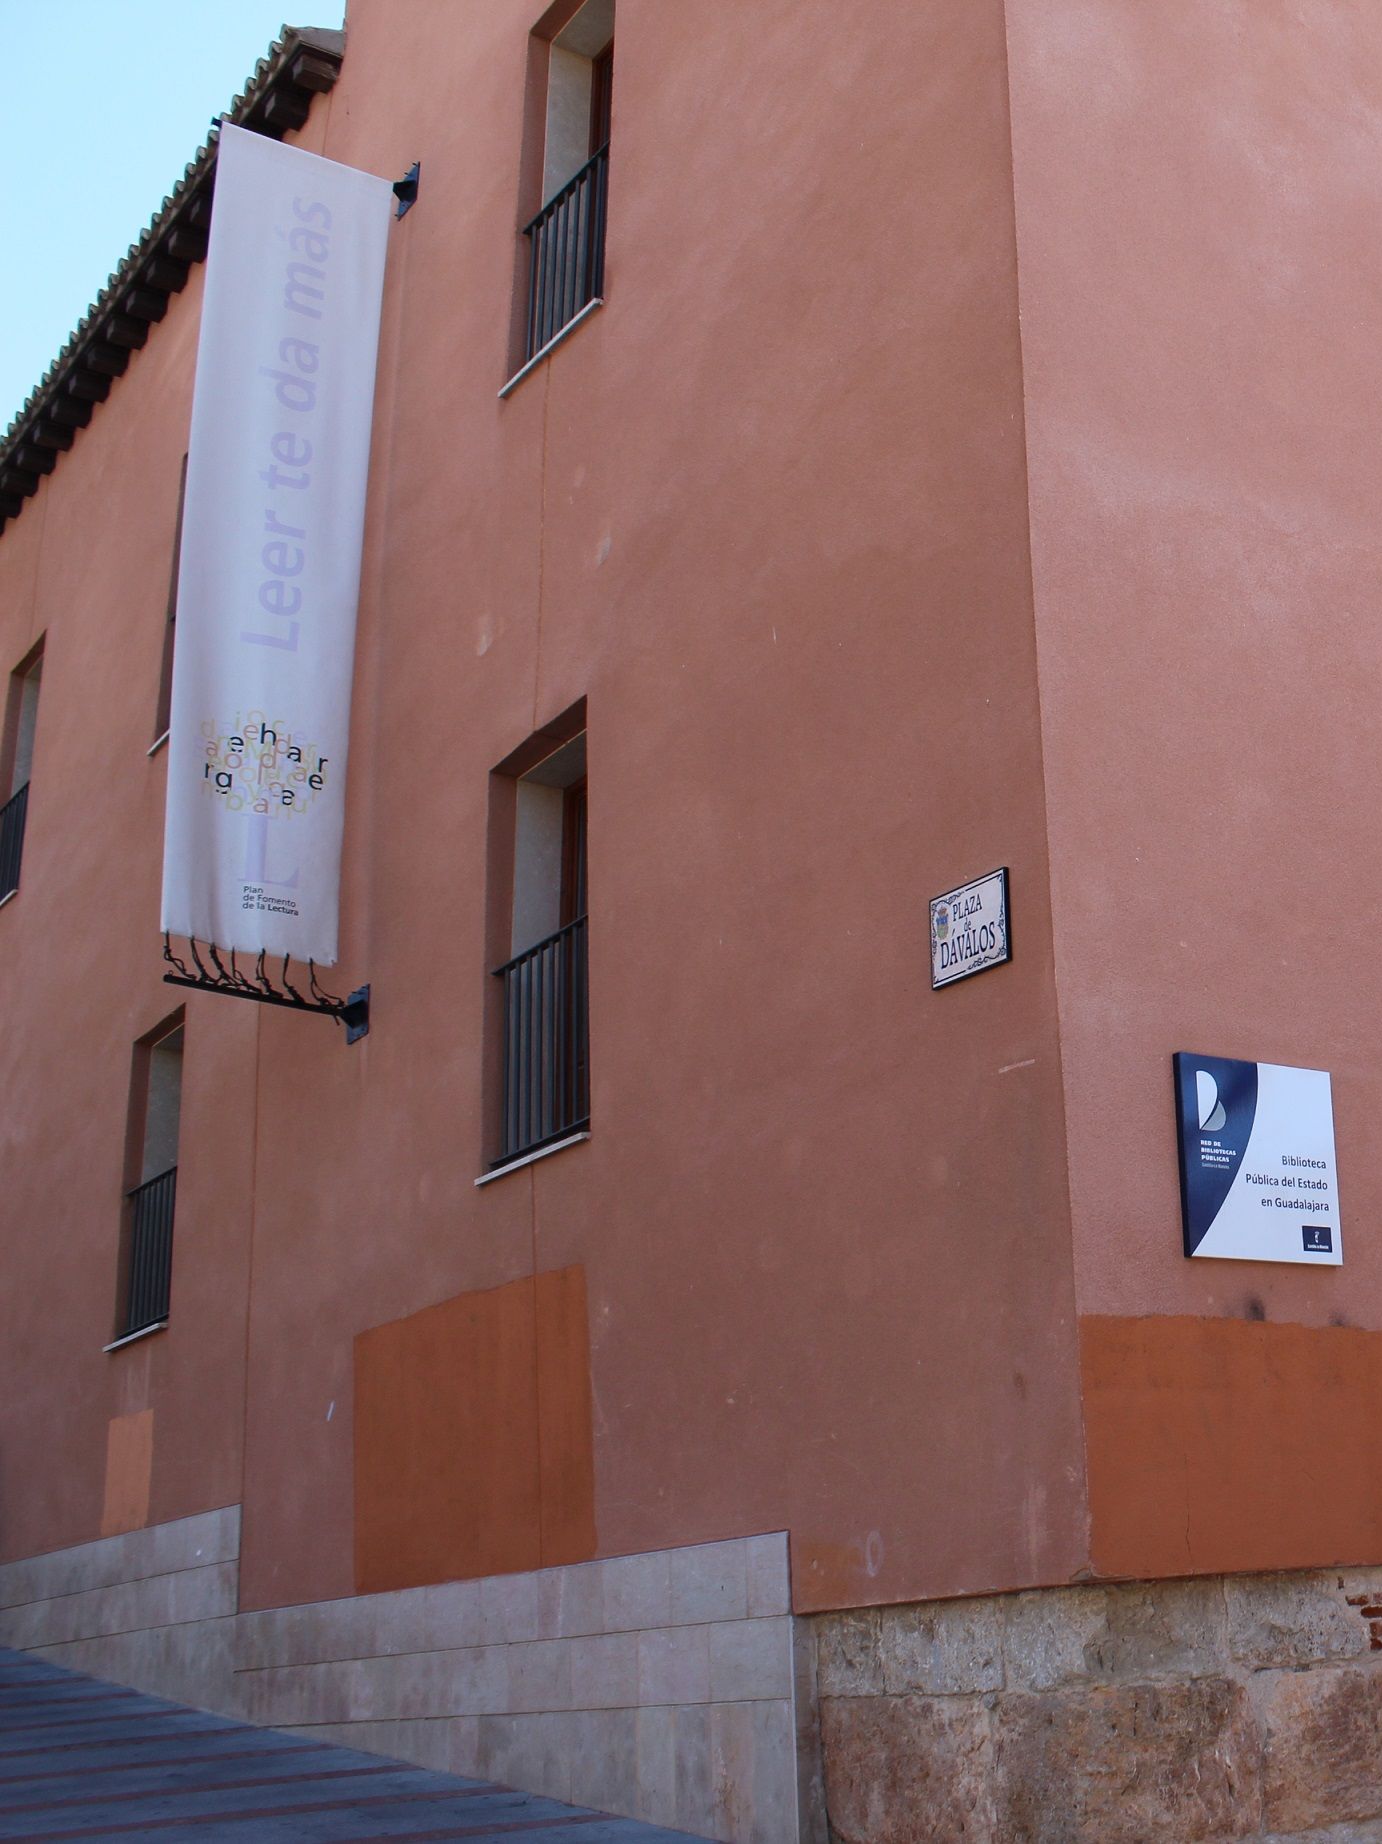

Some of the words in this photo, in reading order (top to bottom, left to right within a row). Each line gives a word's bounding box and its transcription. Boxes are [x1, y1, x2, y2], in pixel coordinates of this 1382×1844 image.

[274, 196, 334, 321] más
[258, 337, 321, 412] da
[258, 430, 314, 492] te
[240, 508, 306, 653] Leer
[243, 885, 264, 894] Plan
[242, 901, 255, 910] de
[256, 901, 266, 910] la
[267, 903, 300, 917] Lectura
[257, 894, 297, 908] Fomento
[952, 893, 982, 921] PLAZA
[963, 917, 973, 932] de
[940, 921, 996, 969] DÁVALOS
[1281, 1155, 1327, 1169] Biblioteca
[1245, 1173, 1280, 1187] Pública
[1281, 1176, 1296, 1188] del
[1297, 1177, 1328, 1191] Estado
[1261, 1198, 1273, 1207] en
[1274, 1197, 1330, 1213] Guadalajara
